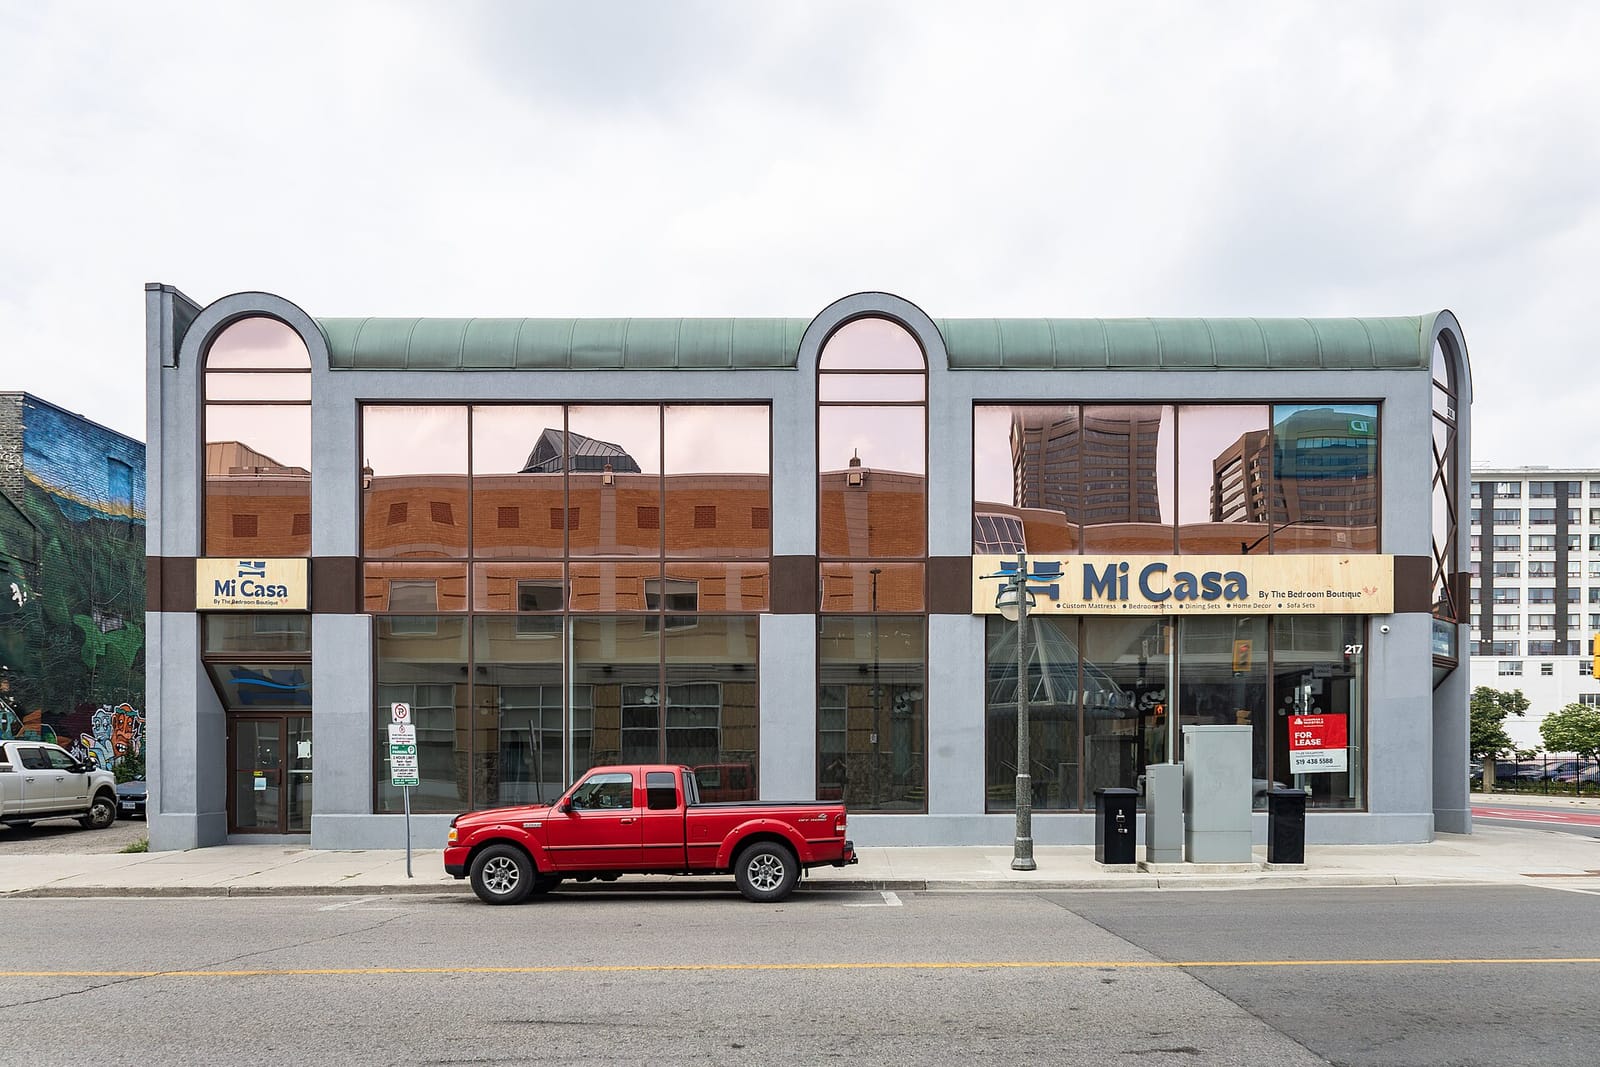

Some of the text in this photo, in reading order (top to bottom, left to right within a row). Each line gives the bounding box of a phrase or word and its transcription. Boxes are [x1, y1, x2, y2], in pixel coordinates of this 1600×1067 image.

[1083, 561, 1250, 602] Mi Casa
[214, 579, 288, 597] Mi Casa
[1258, 590, 1361, 599] By The Bedroom Boutique
[1344, 644, 1362, 654] 217
[1294, 731, 1312, 739] FOR
[1295, 738, 1322, 746] LEASE
